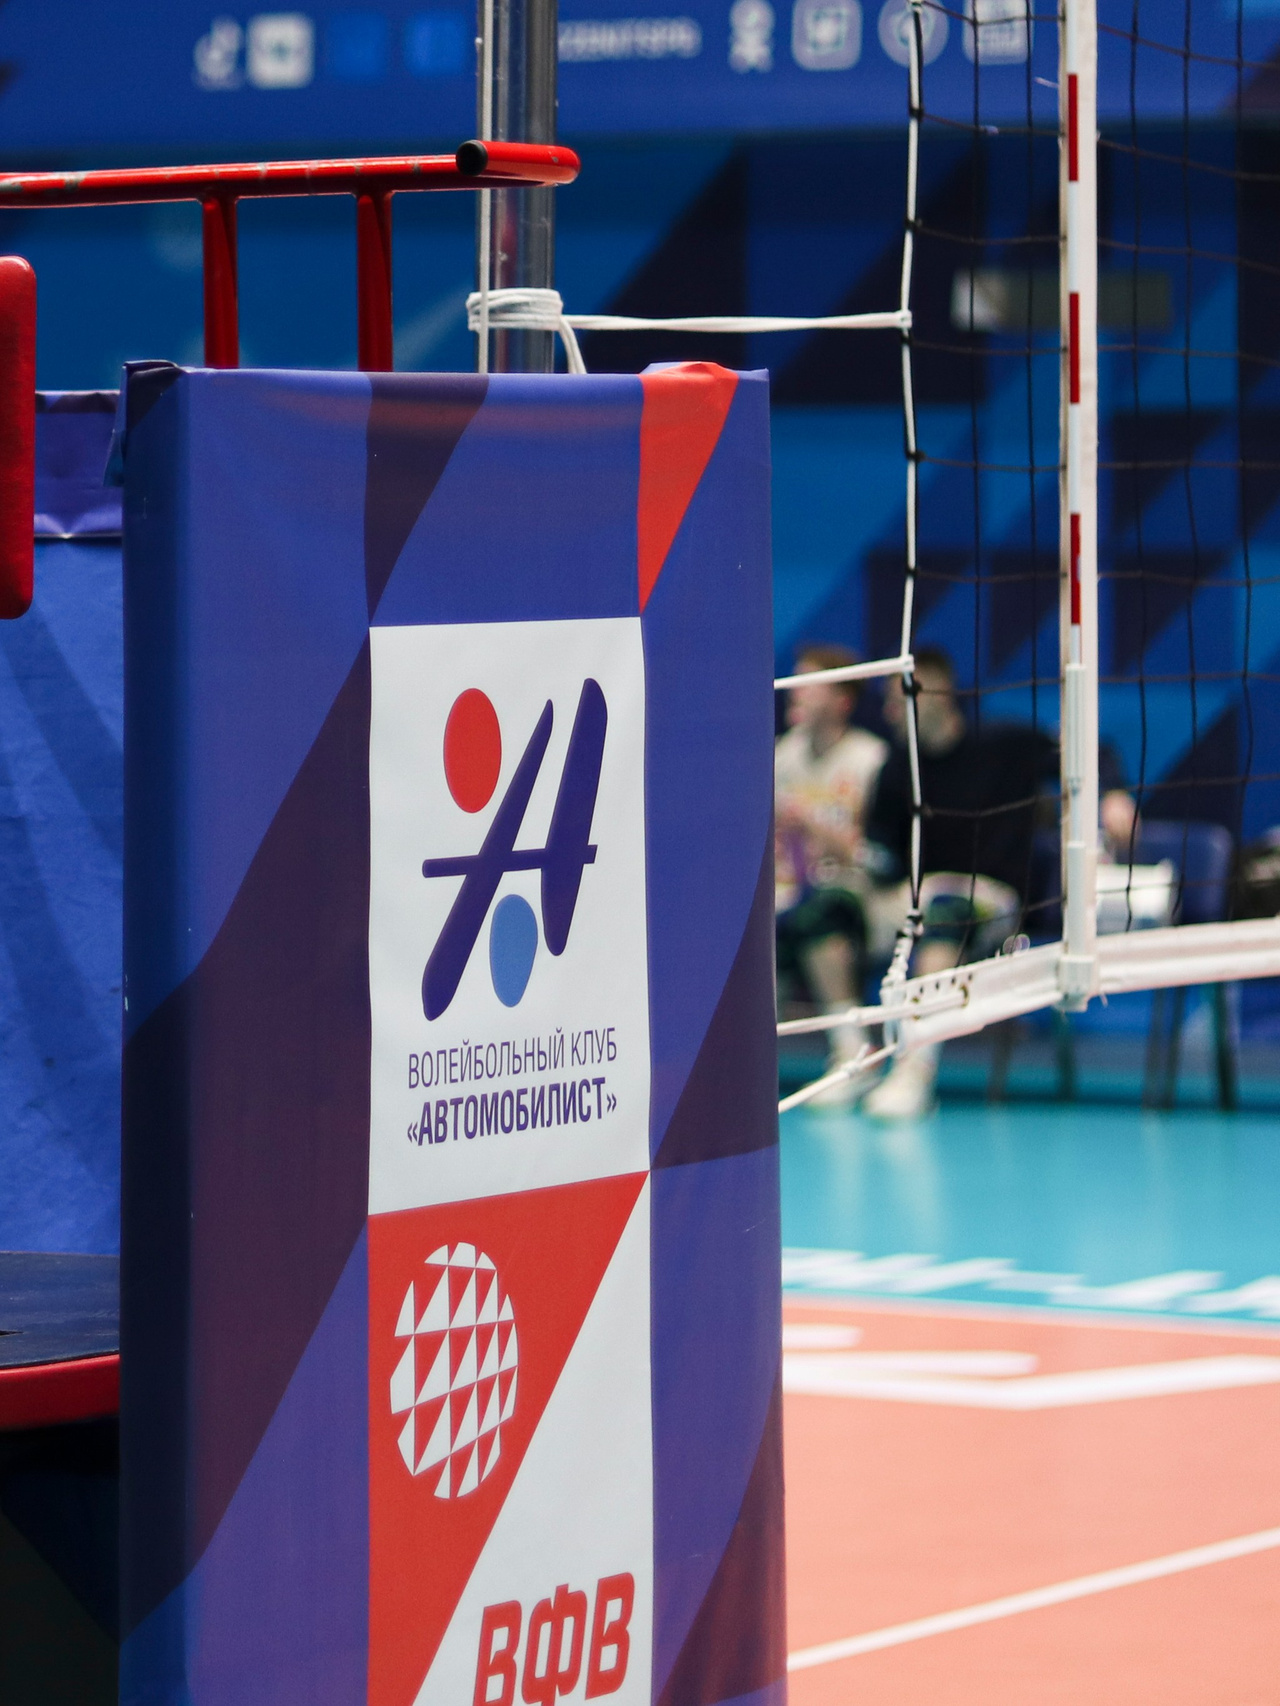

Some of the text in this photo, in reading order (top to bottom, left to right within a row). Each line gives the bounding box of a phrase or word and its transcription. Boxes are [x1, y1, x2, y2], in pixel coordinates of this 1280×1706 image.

[408, 1027, 617, 1089] ВОЛЕЙБОЛЬНЫЙ КЛУБ
[407, 1077, 618, 1146] «АВТОМОБИЛИСТ»
[472, 1571, 636, 1706] ВФВ
